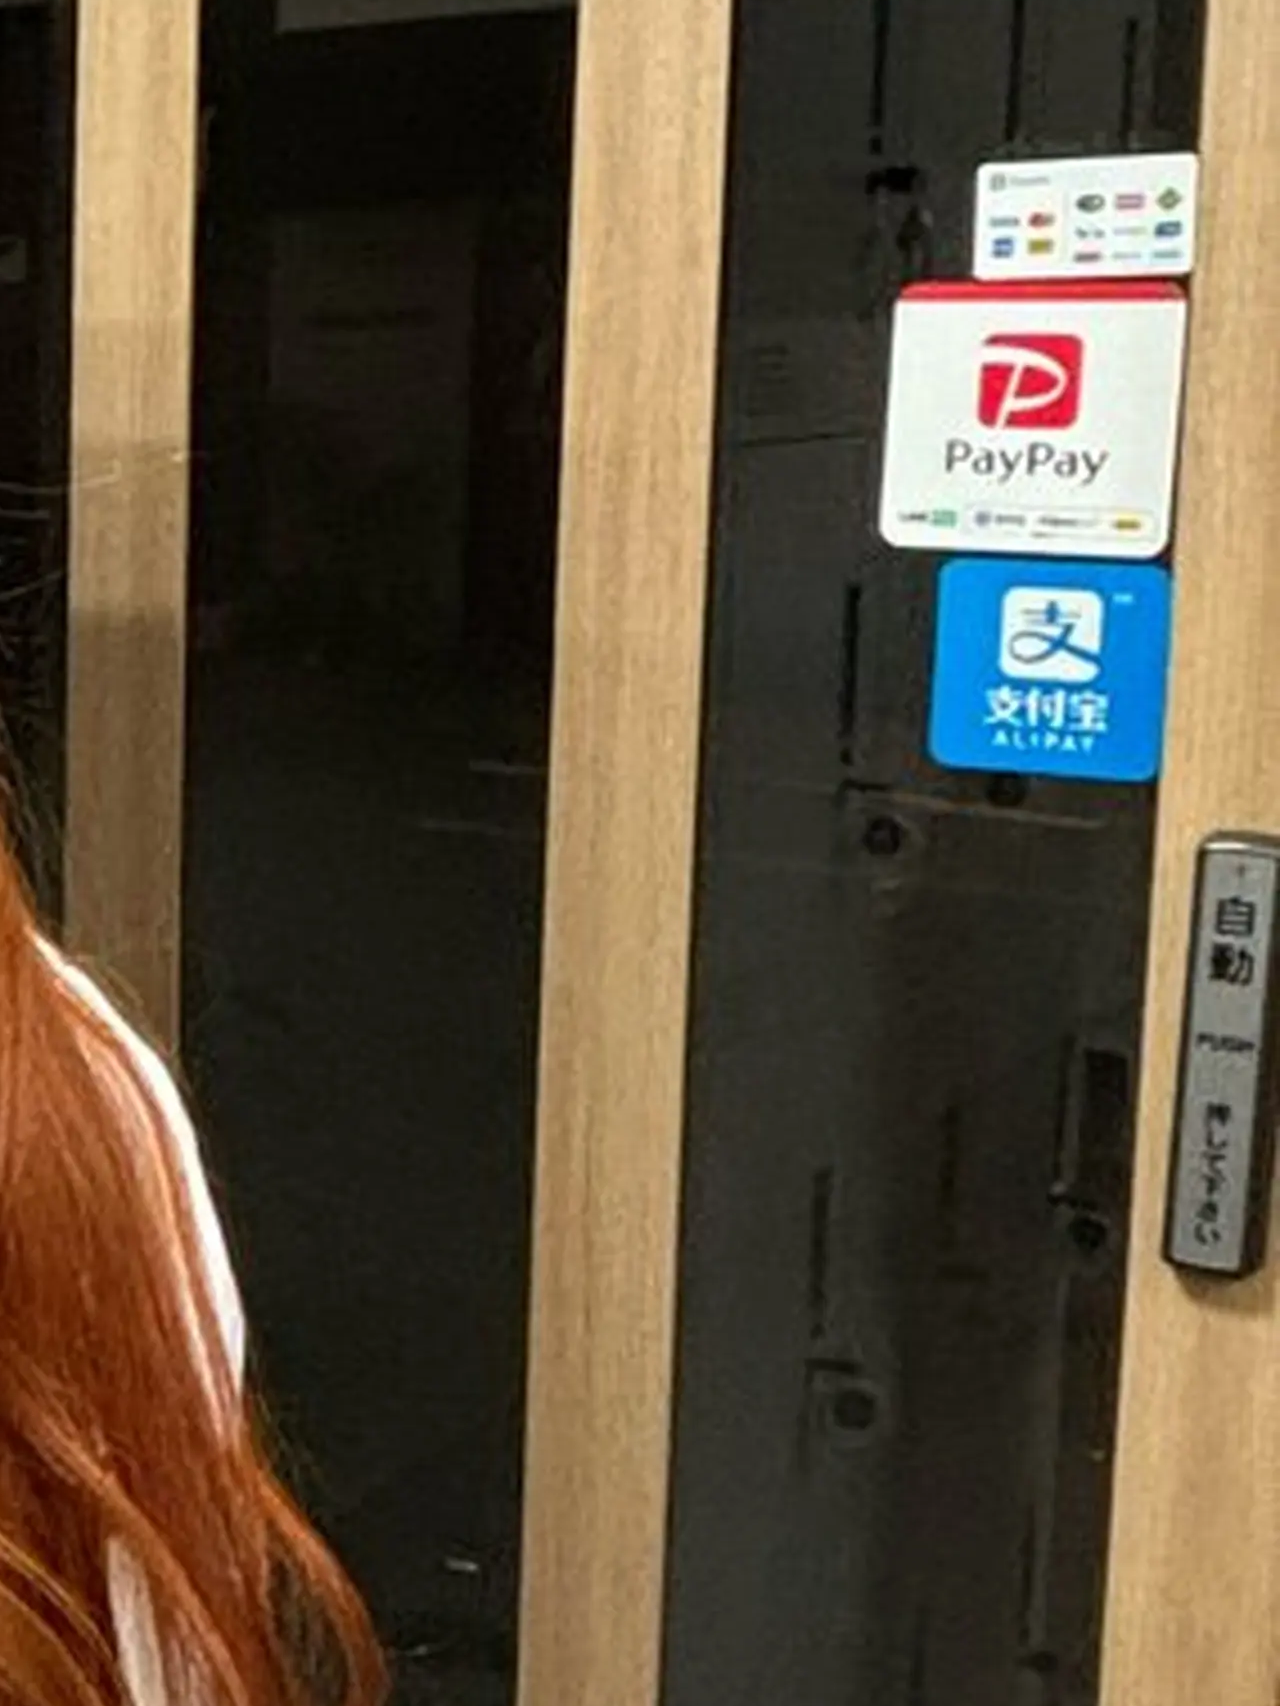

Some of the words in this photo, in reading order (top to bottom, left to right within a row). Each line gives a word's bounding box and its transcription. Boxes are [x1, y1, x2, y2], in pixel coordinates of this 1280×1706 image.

[944, 439, 1109, 486] PayPay
[983, 685, 1109, 734] 支付宝
[1208, 894, 1256, 986] 自動
